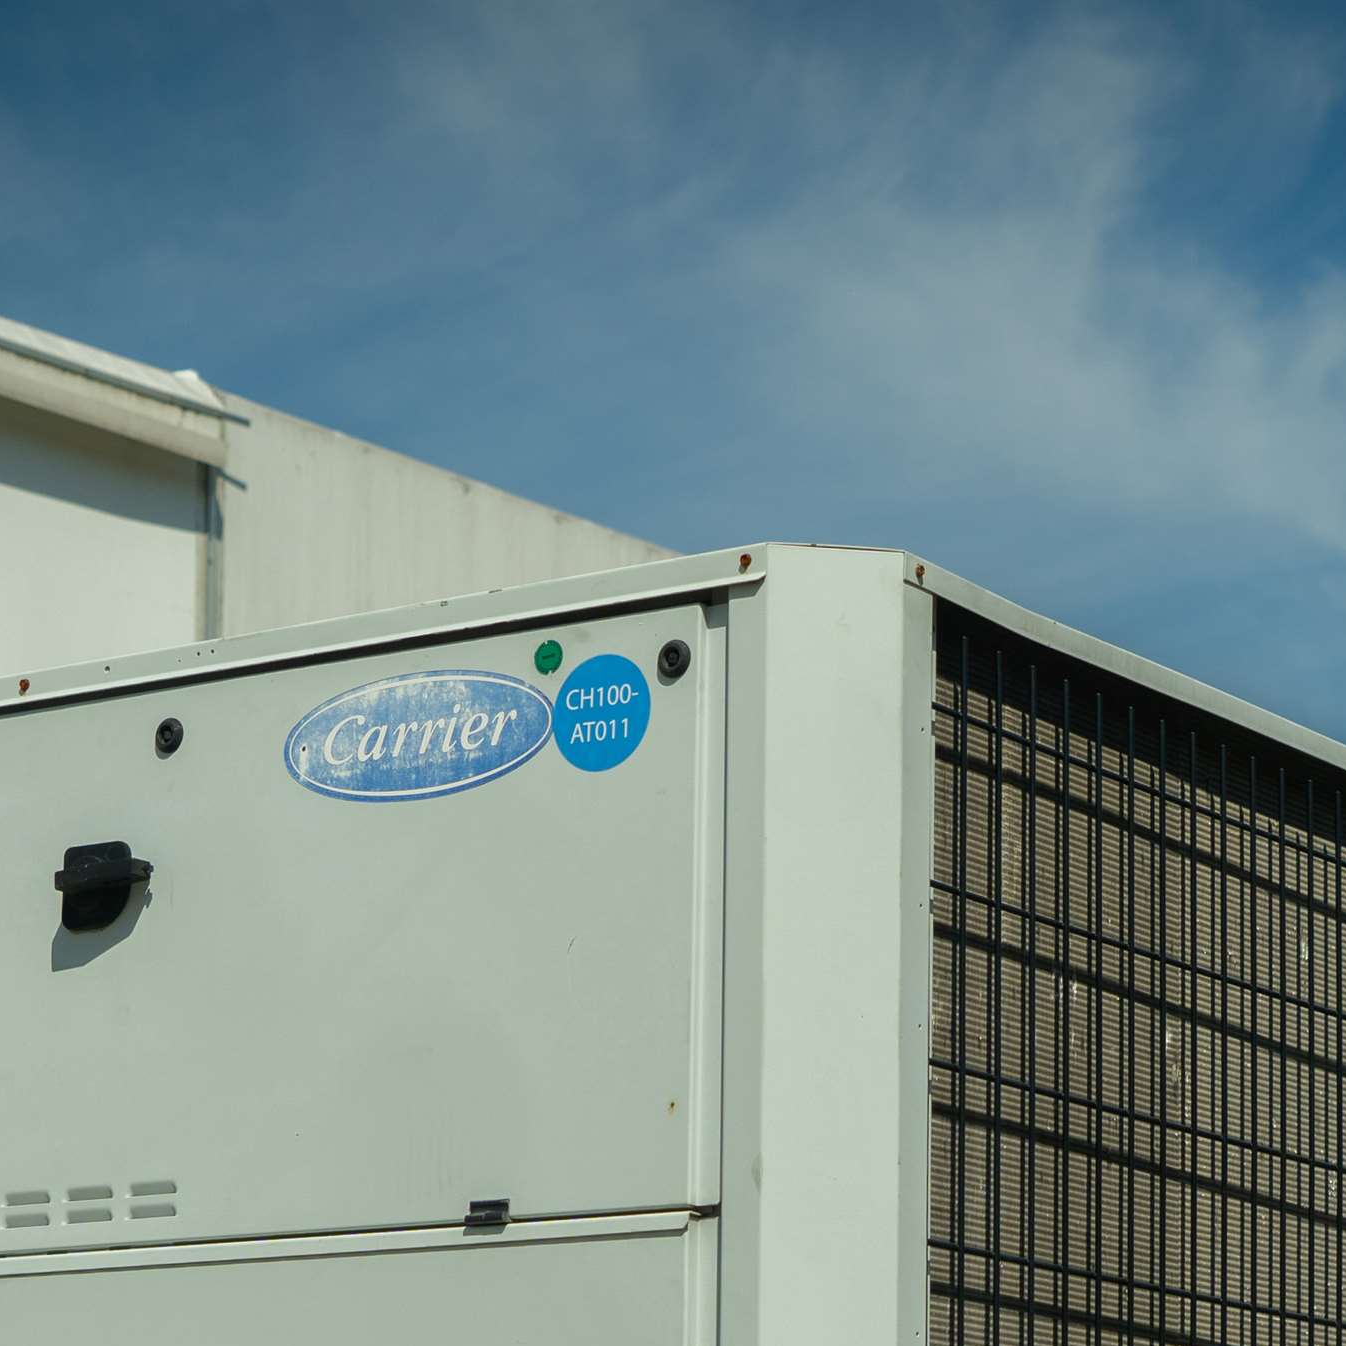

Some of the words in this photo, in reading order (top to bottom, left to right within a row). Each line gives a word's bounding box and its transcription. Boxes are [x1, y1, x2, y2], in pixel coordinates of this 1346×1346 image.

[565, 683, 640, 711] CH100-
[324, 704, 517, 766] Carrier
[570, 718, 629, 745] AT011
